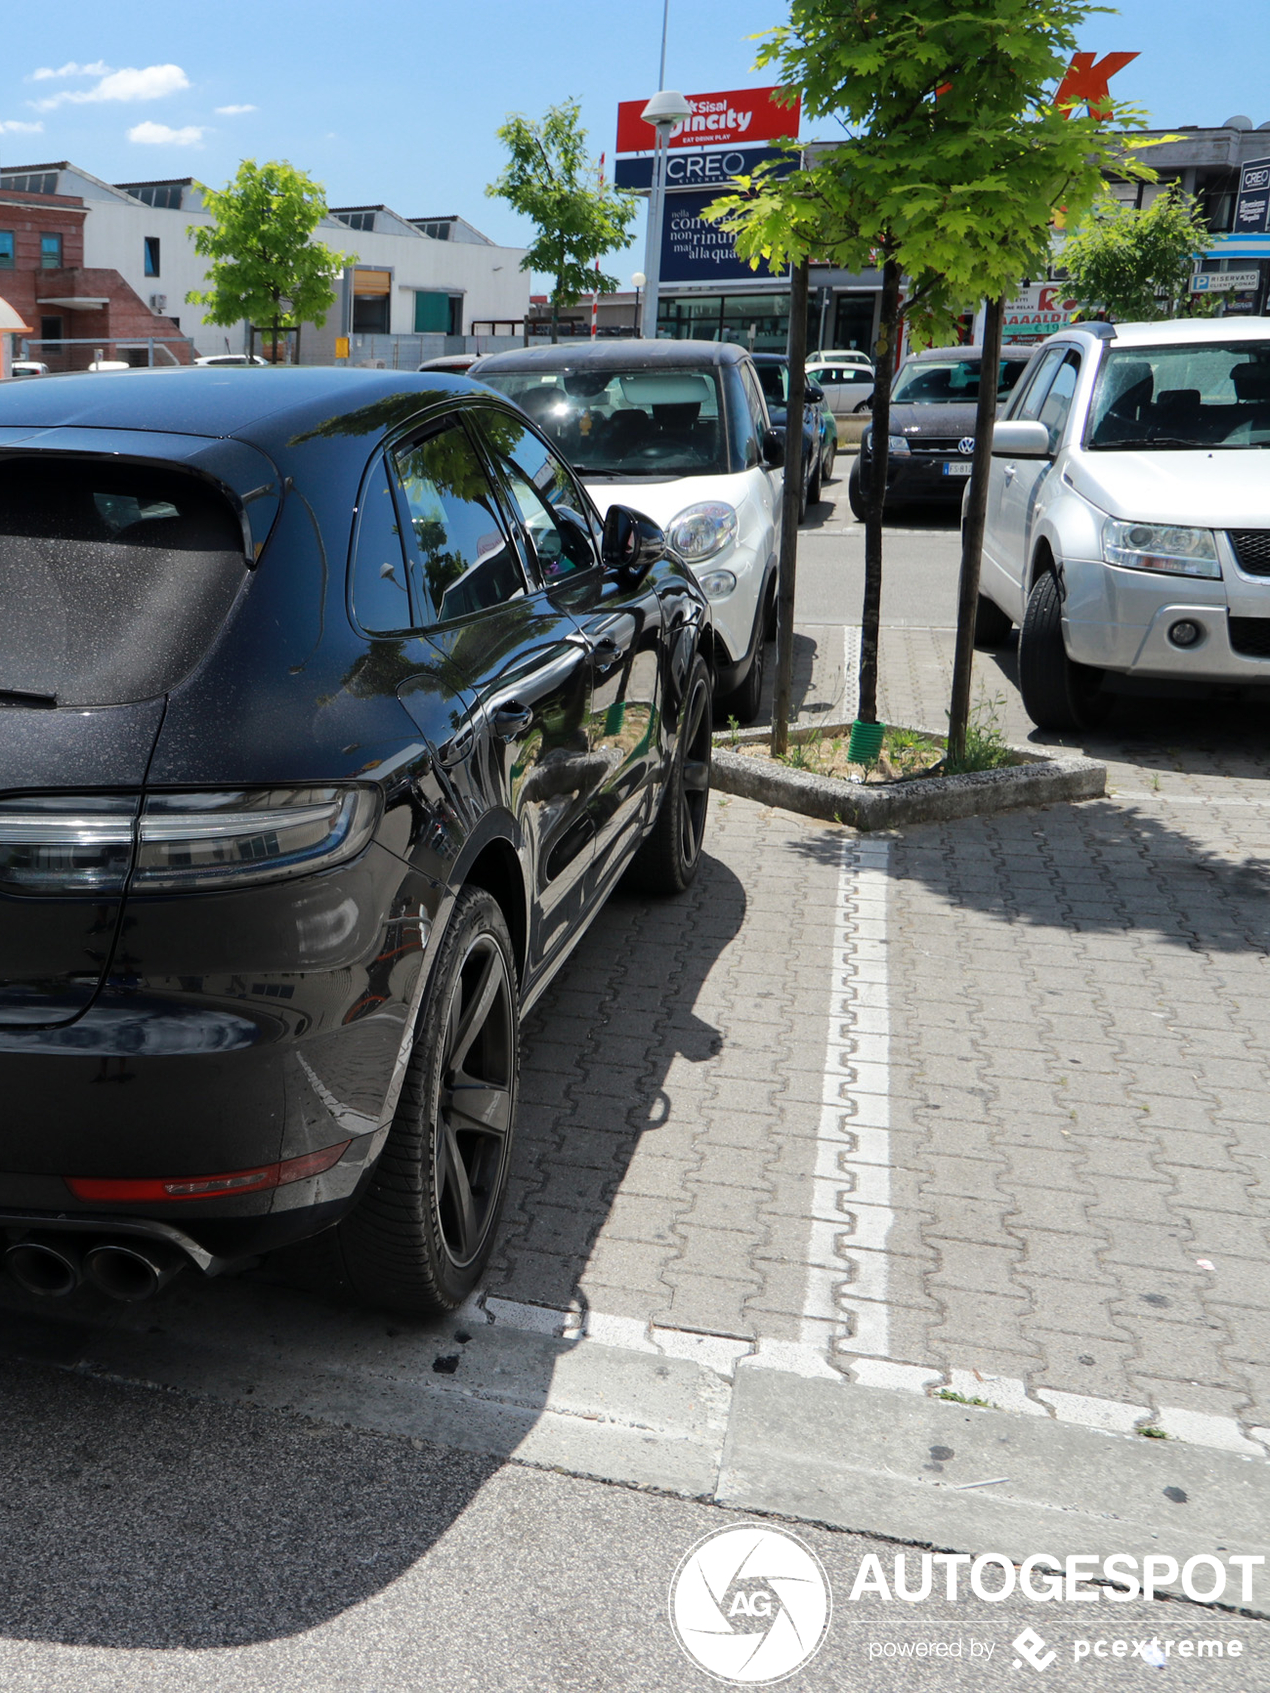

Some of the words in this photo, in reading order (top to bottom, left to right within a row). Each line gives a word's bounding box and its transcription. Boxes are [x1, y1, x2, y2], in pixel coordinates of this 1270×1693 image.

[698, 100, 728, 114] Sisal
[714, 133, 731, 141] PLAY
[667, 152, 745, 179] CREO
[1245, 170, 1268, 185] CREO
[671, 209, 690, 218] nella
[670, 231, 692, 240] non
[673, 242, 692, 252] mai
[688, 246, 710, 259] alla
[1211, 274, 1256, 282] RISERVATO
